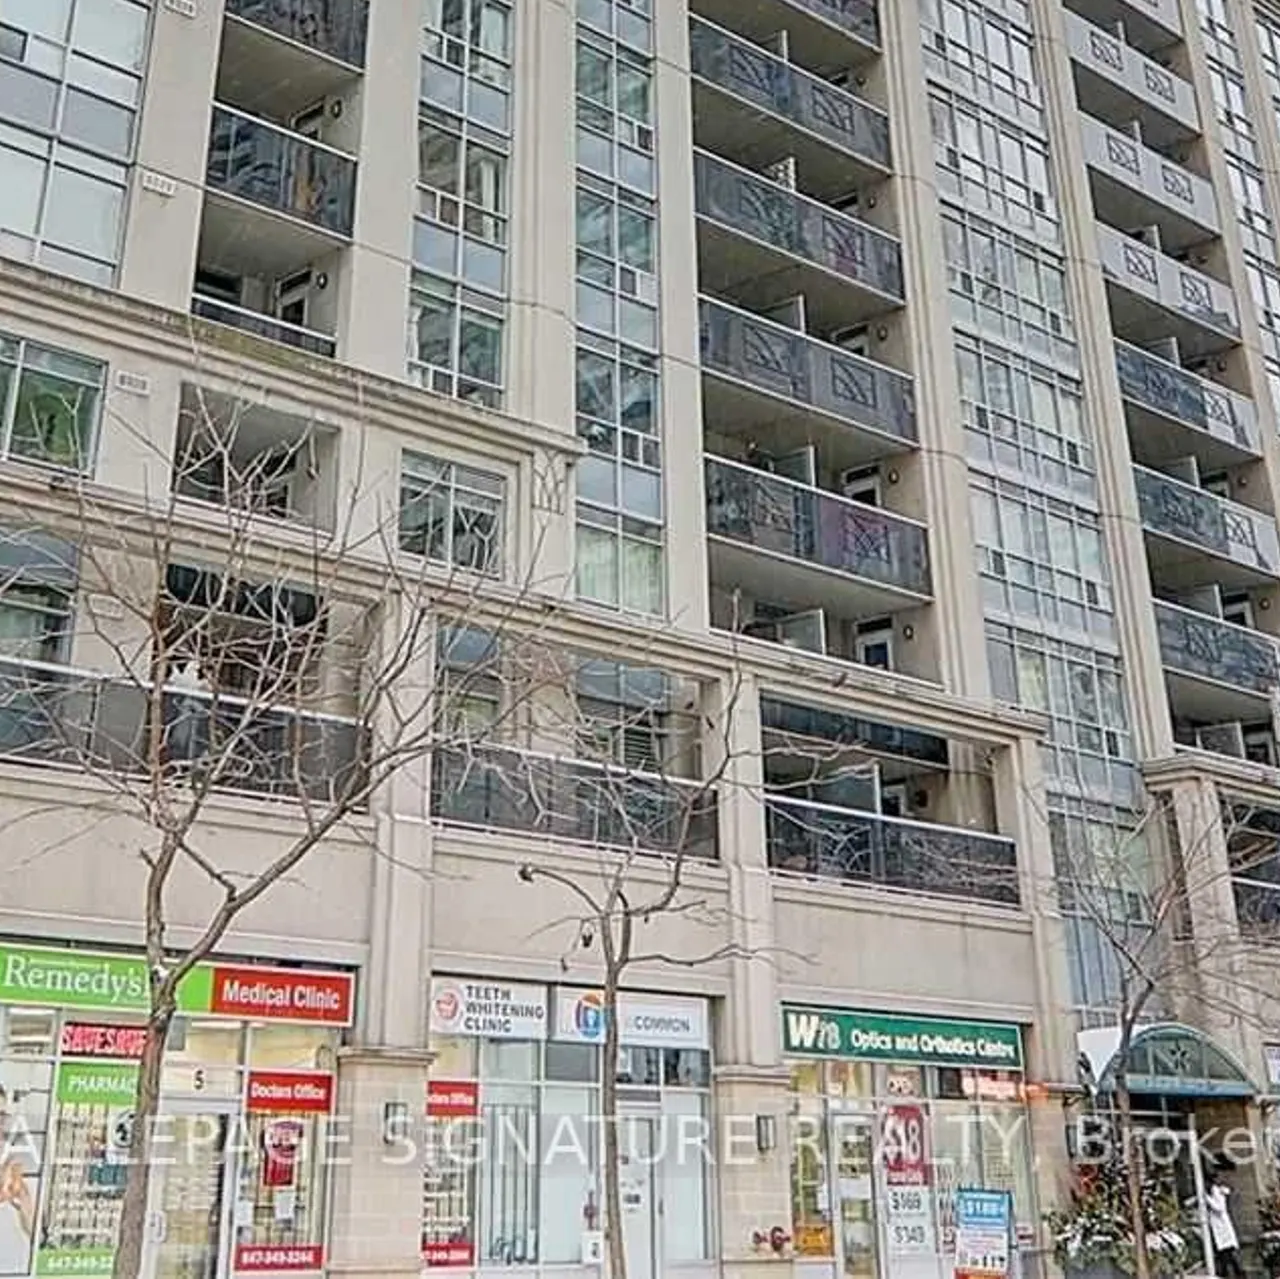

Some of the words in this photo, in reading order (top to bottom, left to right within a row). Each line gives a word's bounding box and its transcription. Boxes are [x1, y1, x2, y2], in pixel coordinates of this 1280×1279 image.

[4, 952, 141, 1003] Remedy's
[222, 978, 291, 1007] Medical
[293, 983, 341, 1011] Clinic
[465, 985, 511, 1001] TEETH
[465, 1002, 544, 1020] WHITENING
[464, 1019, 512, 1033] CLINIC
[851, 1028, 893, 1053] Optics
[895, 1033, 919, 1052] and
[920, 1035, 977, 1057] Orthotics
[67, 1074, 138, 1096] PHARMAC
[293, 1082, 326, 1100] Office
